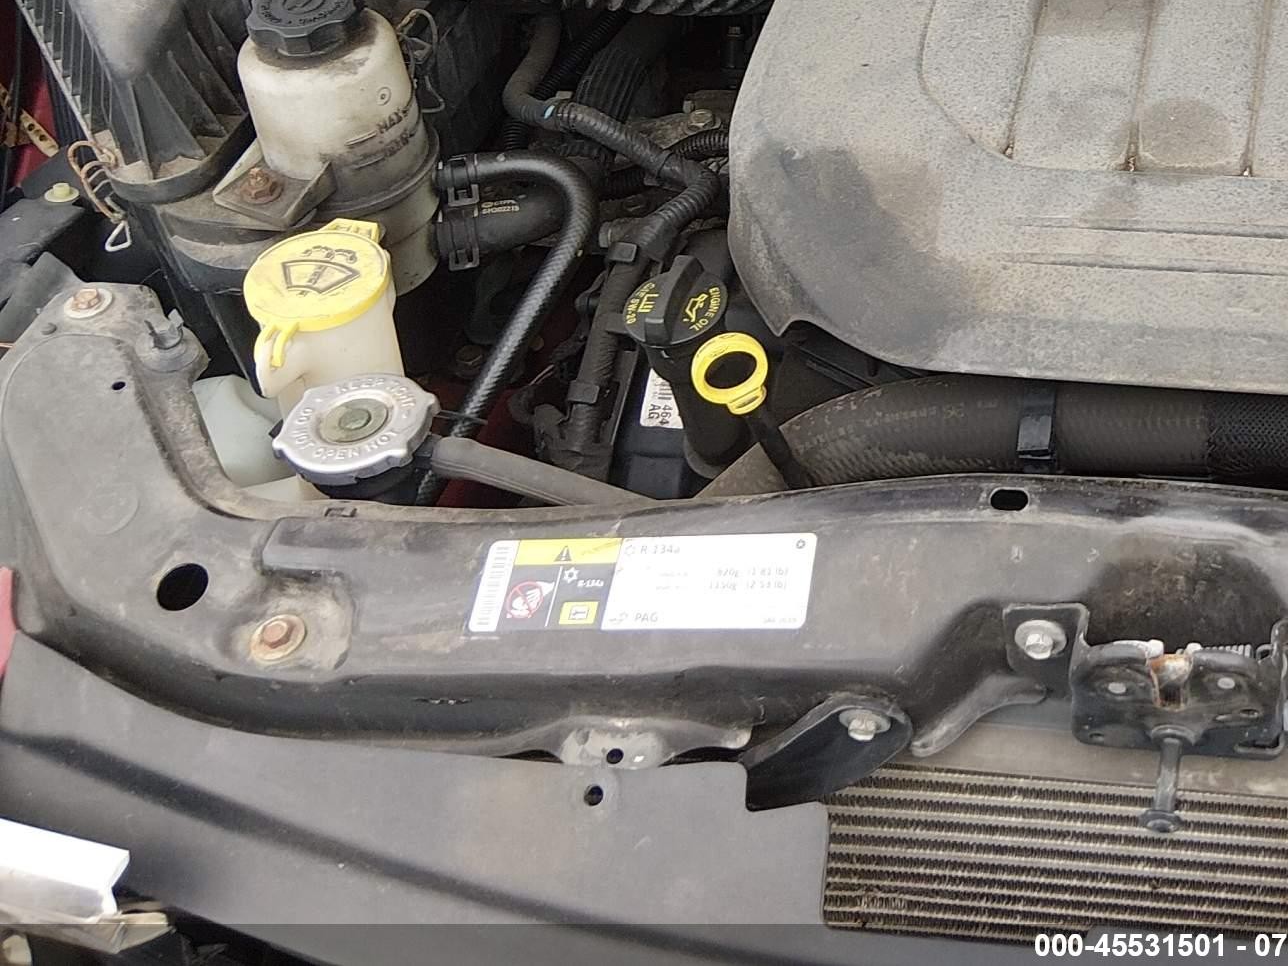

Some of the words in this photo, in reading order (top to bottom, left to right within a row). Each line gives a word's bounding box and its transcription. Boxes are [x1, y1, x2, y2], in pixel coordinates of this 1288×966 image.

[704, 287, 721, 320] ENGINE
[688, 317, 709, 332] OIL
[335, 377, 386, 395] KEEP
[648, 403, 661, 420] AG
[313, 447, 361, 460] OPEN
[365, 430, 400, 453] HOT
[634, 612, 660, 623] PAG
